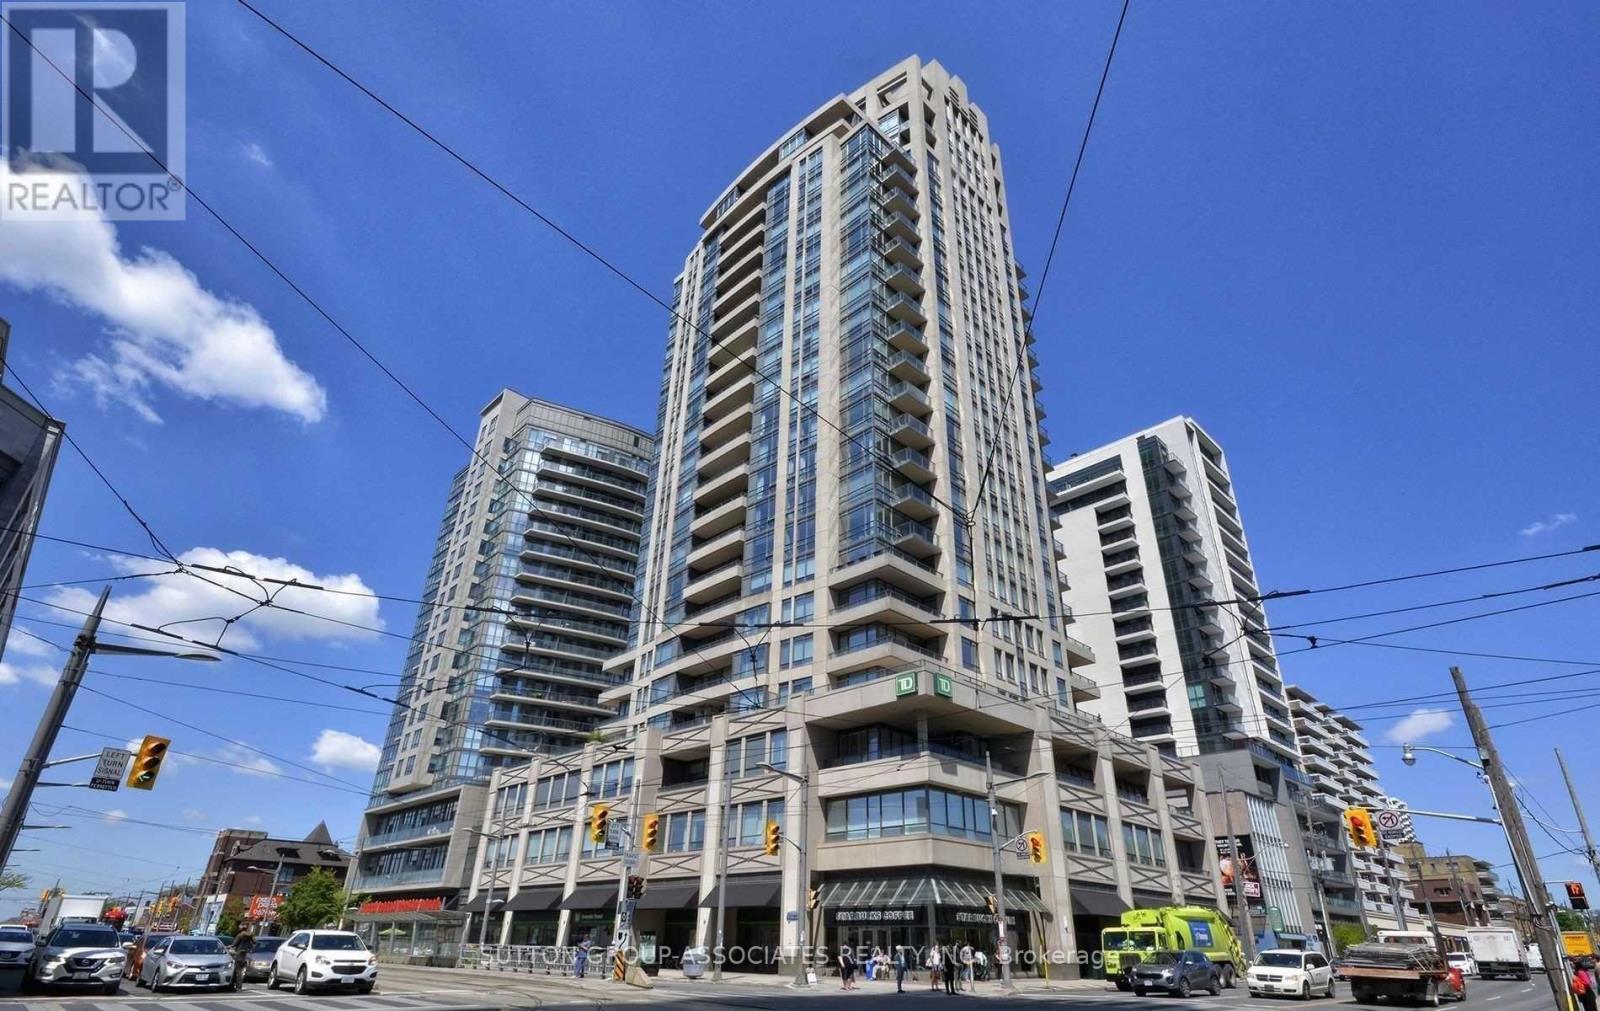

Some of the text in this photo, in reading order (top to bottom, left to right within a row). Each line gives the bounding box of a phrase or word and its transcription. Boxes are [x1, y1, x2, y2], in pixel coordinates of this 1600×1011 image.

[898, 677, 913, 690] TD
[938, 678, 950, 692] TD
[103, 759, 124, 767] TURN
[96, 767, 121, 775] SIGNAL
[835, 910, 915, 921] STARBUCKS COFFEE
